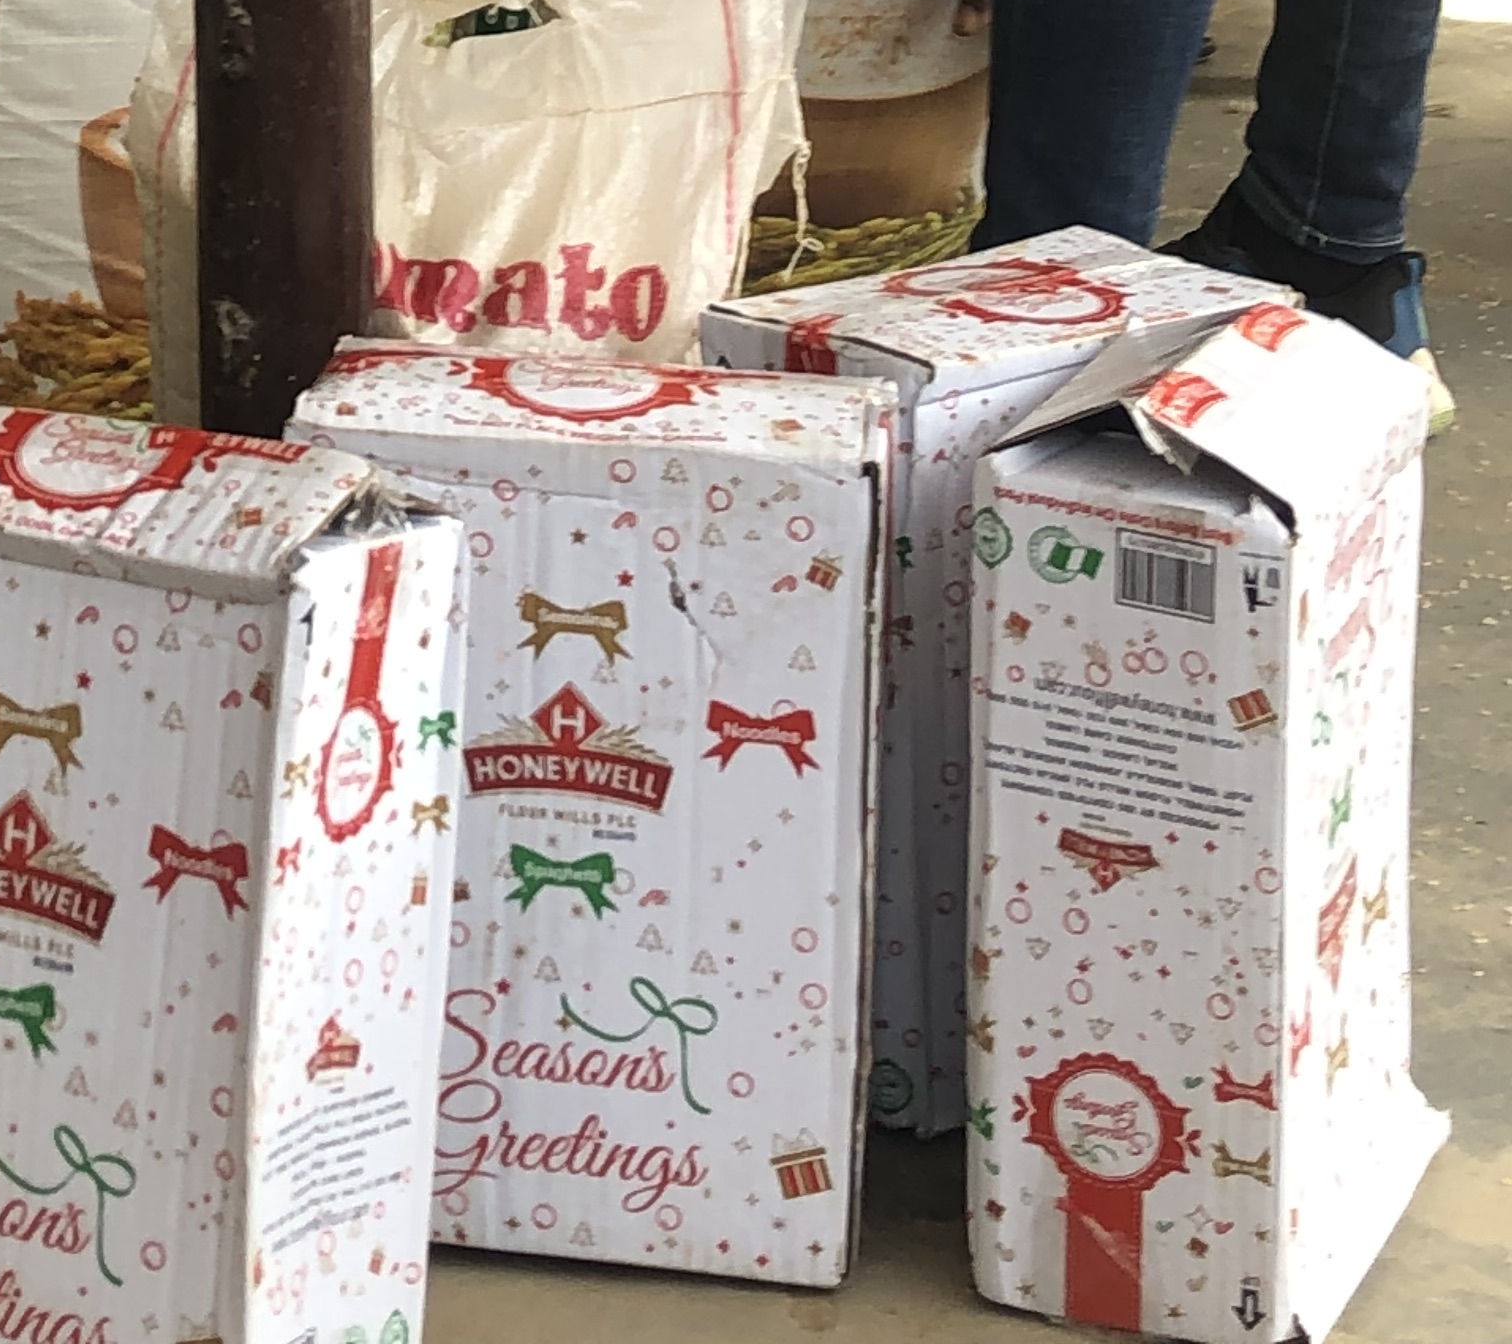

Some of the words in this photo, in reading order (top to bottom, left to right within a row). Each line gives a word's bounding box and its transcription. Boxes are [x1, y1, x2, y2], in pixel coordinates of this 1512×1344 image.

[372, 242, 671, 343] mato
[550, 703, 587, 738] H
[473, 749, 666, 799] HONEYWELL
[1, 814, 37, 853] H
[433, 1079, 711, 1212] Greetings
